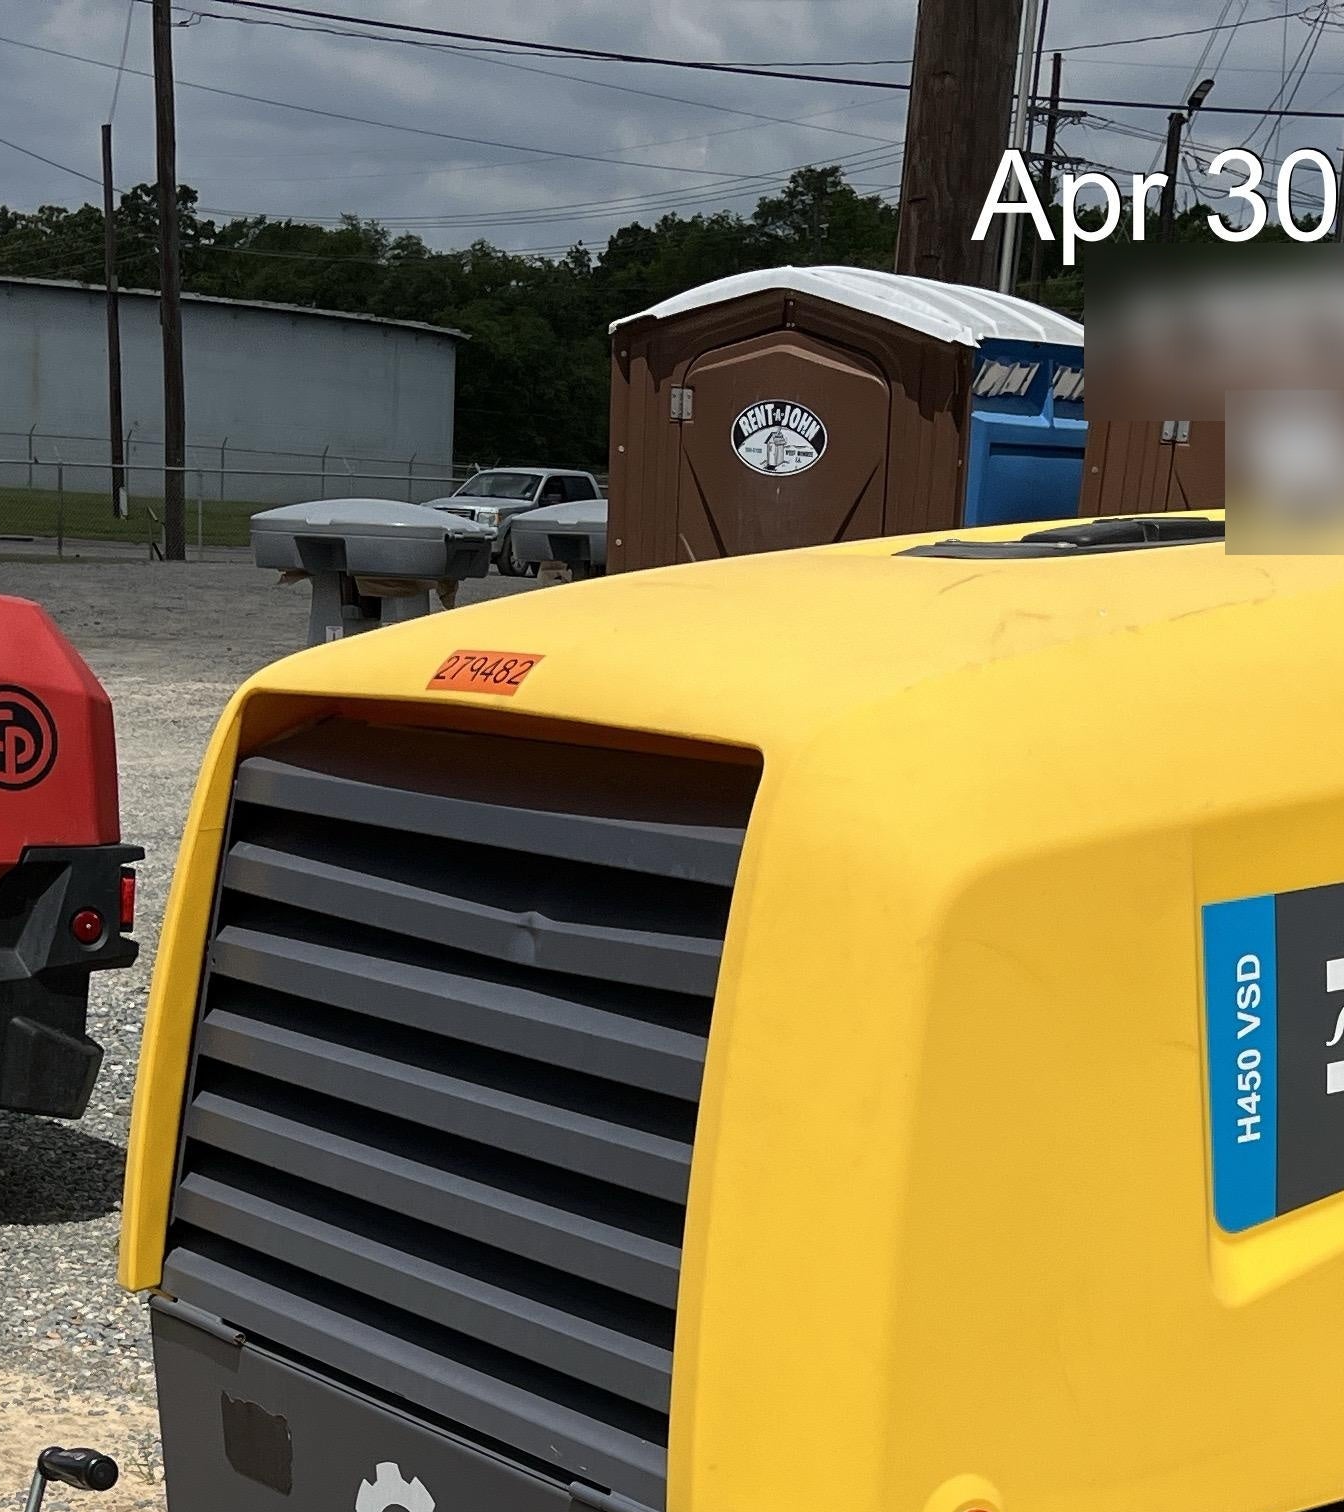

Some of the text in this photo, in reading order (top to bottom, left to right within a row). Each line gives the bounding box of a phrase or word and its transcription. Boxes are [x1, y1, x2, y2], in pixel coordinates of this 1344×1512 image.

[433, 655, 535, 686] 279482
[1236, 953, 1262, 1145] H450 VSD
